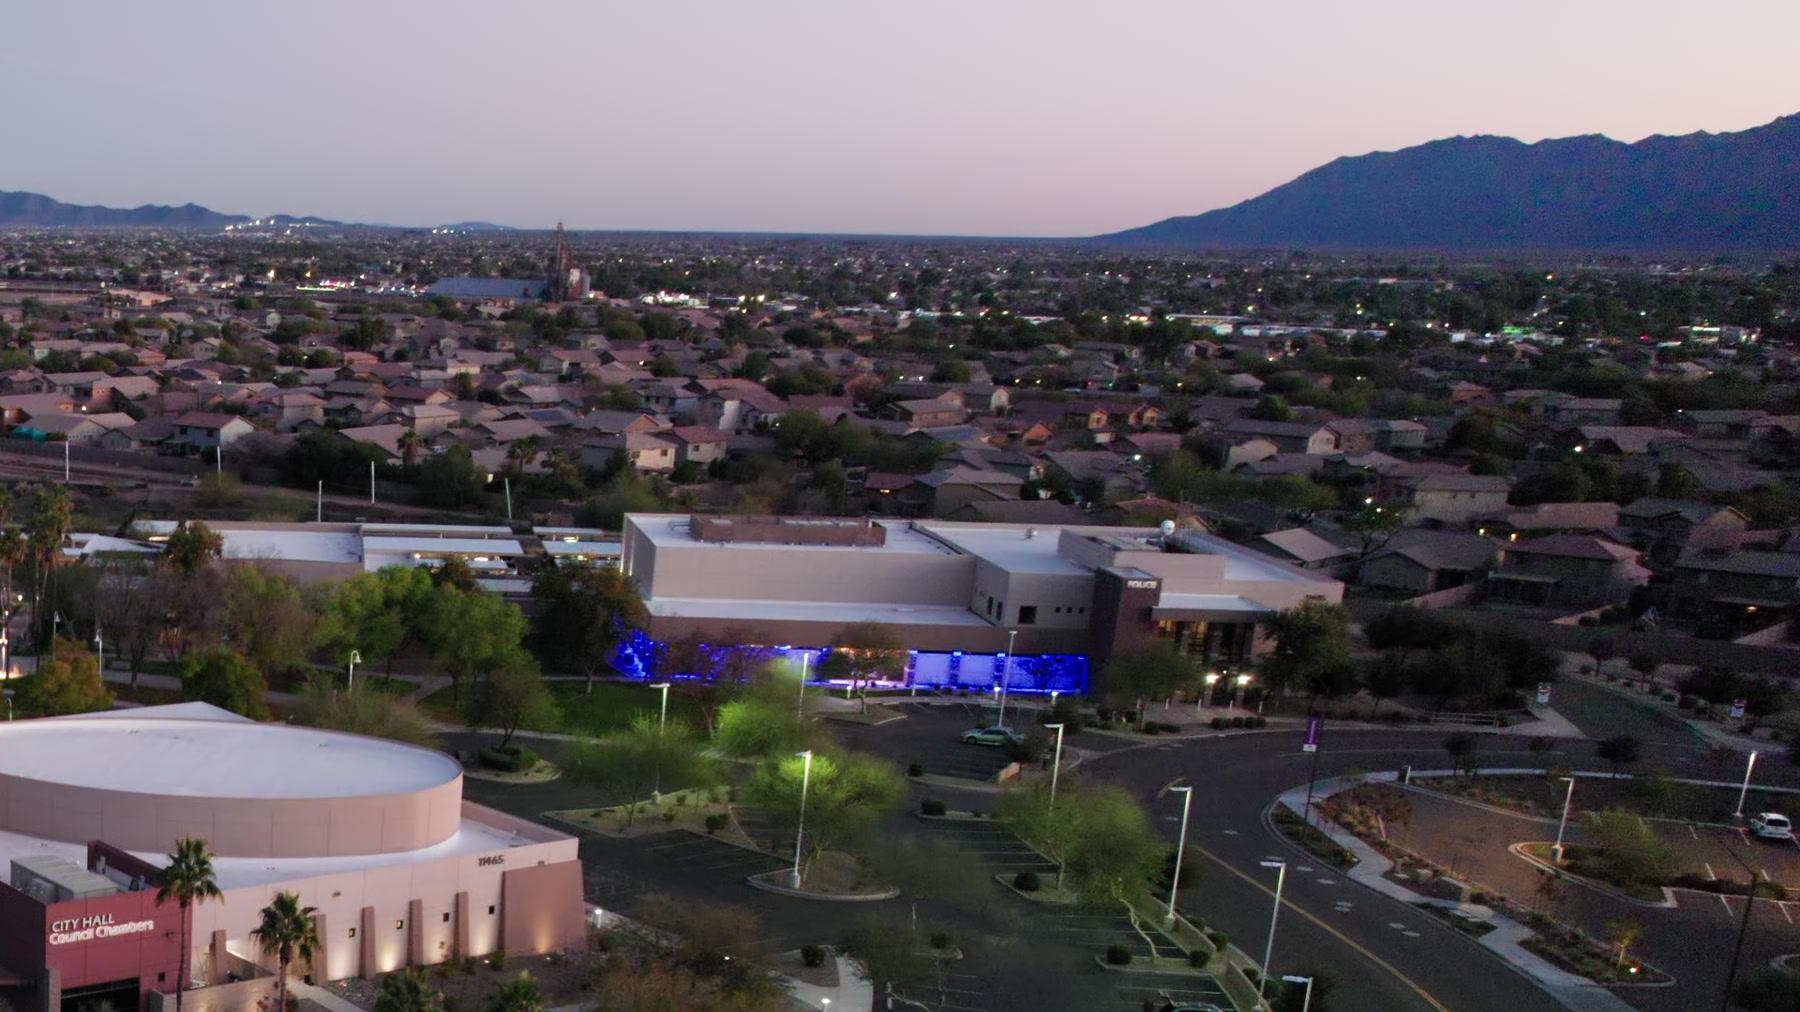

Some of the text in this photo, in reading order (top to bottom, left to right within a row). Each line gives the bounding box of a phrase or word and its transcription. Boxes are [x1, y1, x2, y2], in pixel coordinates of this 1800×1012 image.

[1128, 580, 1157, 589] POLICE
[52, 913, 115, 932] CITY HALL
[49, 920, 155, 945] Council Chambers
